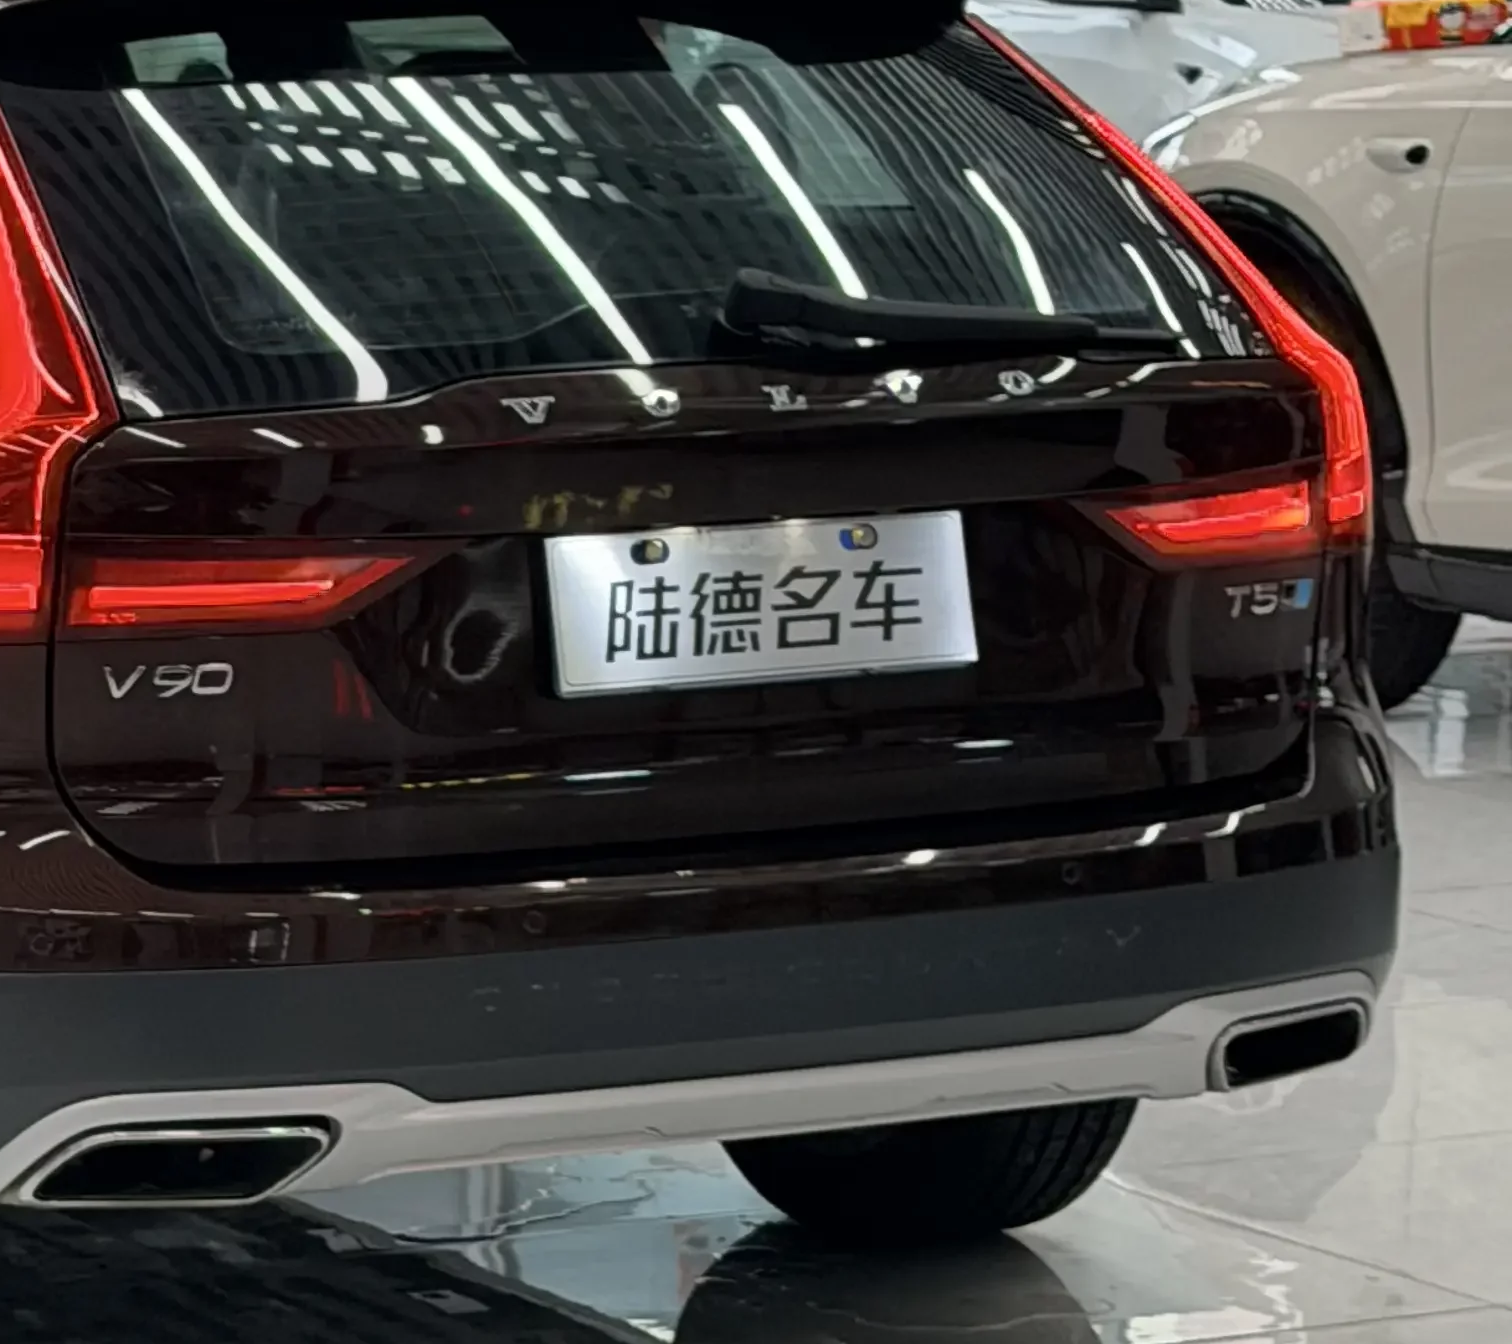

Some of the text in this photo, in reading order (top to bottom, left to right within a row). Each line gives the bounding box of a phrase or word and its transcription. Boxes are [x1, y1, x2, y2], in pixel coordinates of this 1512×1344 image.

[500, 368, 1037, 424] VOLVO
[605, 560, 924, 664] 陆德名车
[1224, 582, 1278, 618] T5
[102, 662, 234, 699] V90
